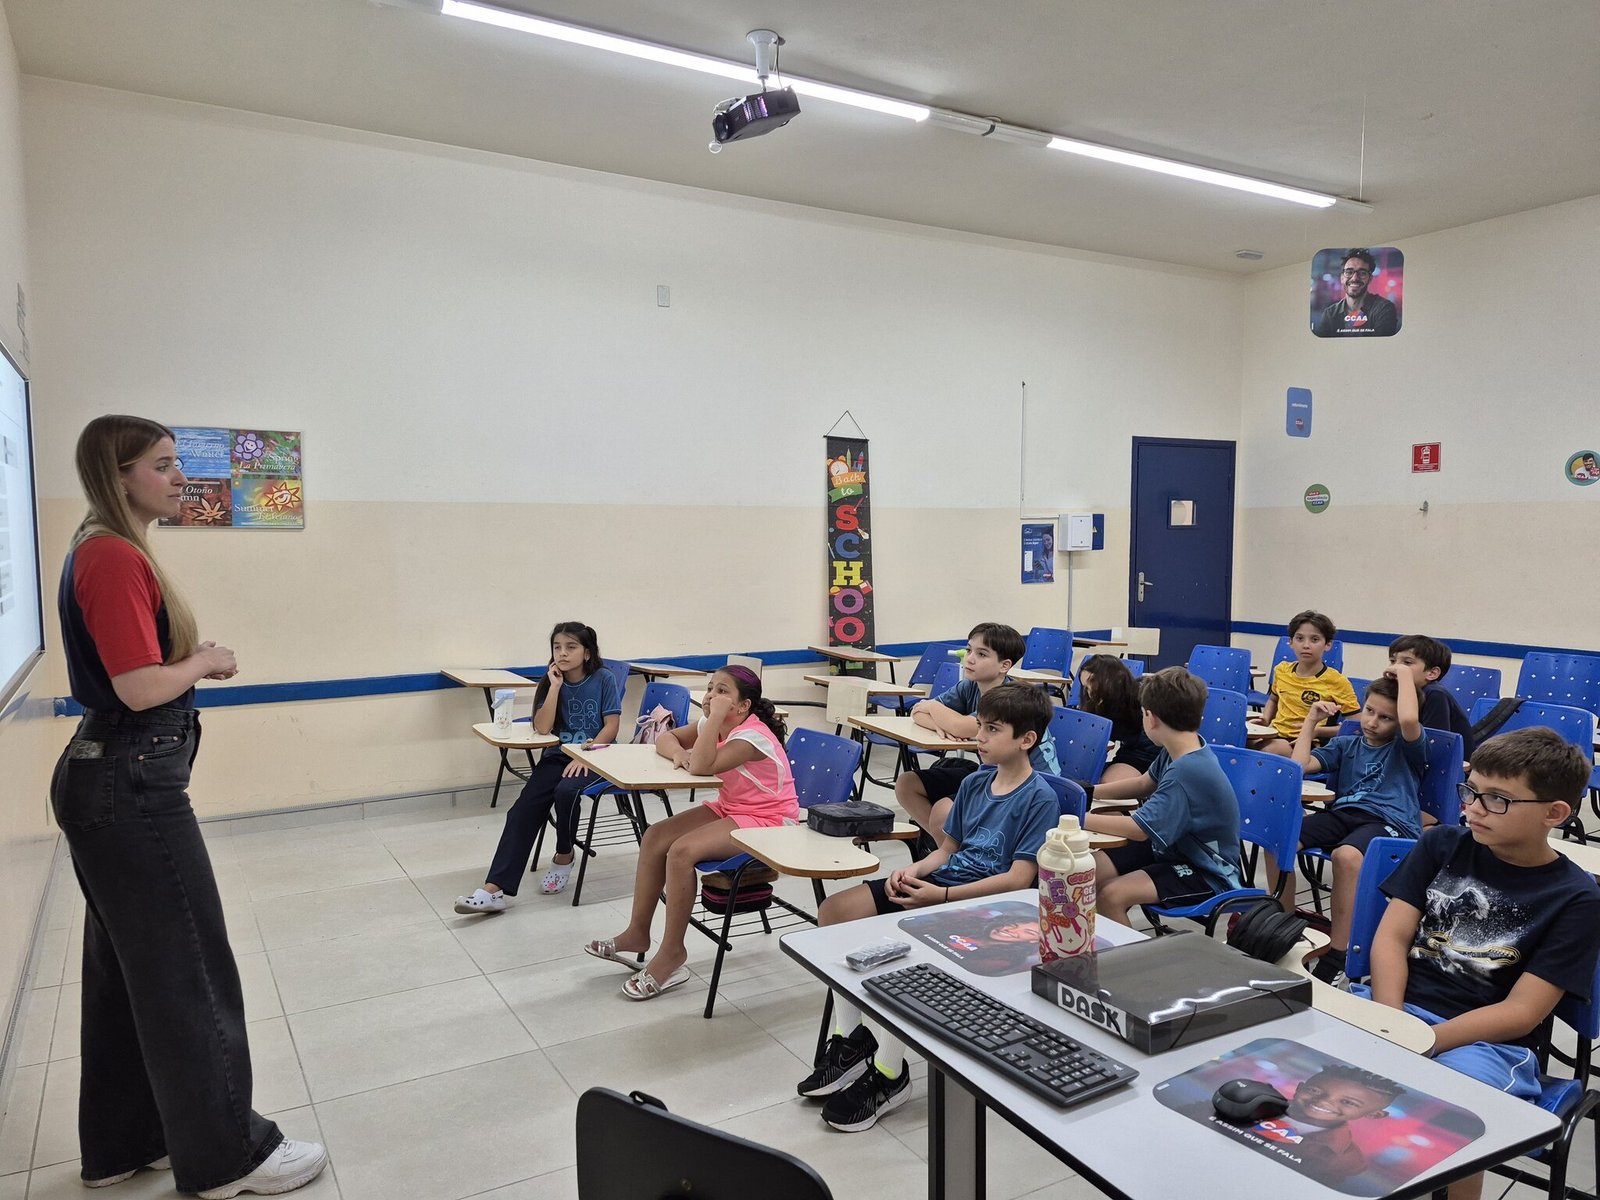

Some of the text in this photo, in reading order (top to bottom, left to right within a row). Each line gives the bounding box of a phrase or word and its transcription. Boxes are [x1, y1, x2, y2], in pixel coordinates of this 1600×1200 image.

[190, 449, 225, 458] Winter
[268, 453, 300, 465] Spring
[240, 461, 296, 470] La Primavera
[835, 472, 862, 485] Back
[186, 485, 213, 494] Otoño
[841, 487, 855, 496] to
[234, 503, 274, 512] Summer
[568, 699, 598, 715] DA
[949, 934, 978, 951] CCAA
[1061, 987, 1121, 1033] DASK
[1255, 1119, 1304, 1145] CAA
[1214, 1120, 1244, 1135] ASSIM
[1243, 1133, 1265, 1145] QUE
[1263, 1141, 1278, 1151] SE
[1277, 1149, 1302, 1164] FALA
